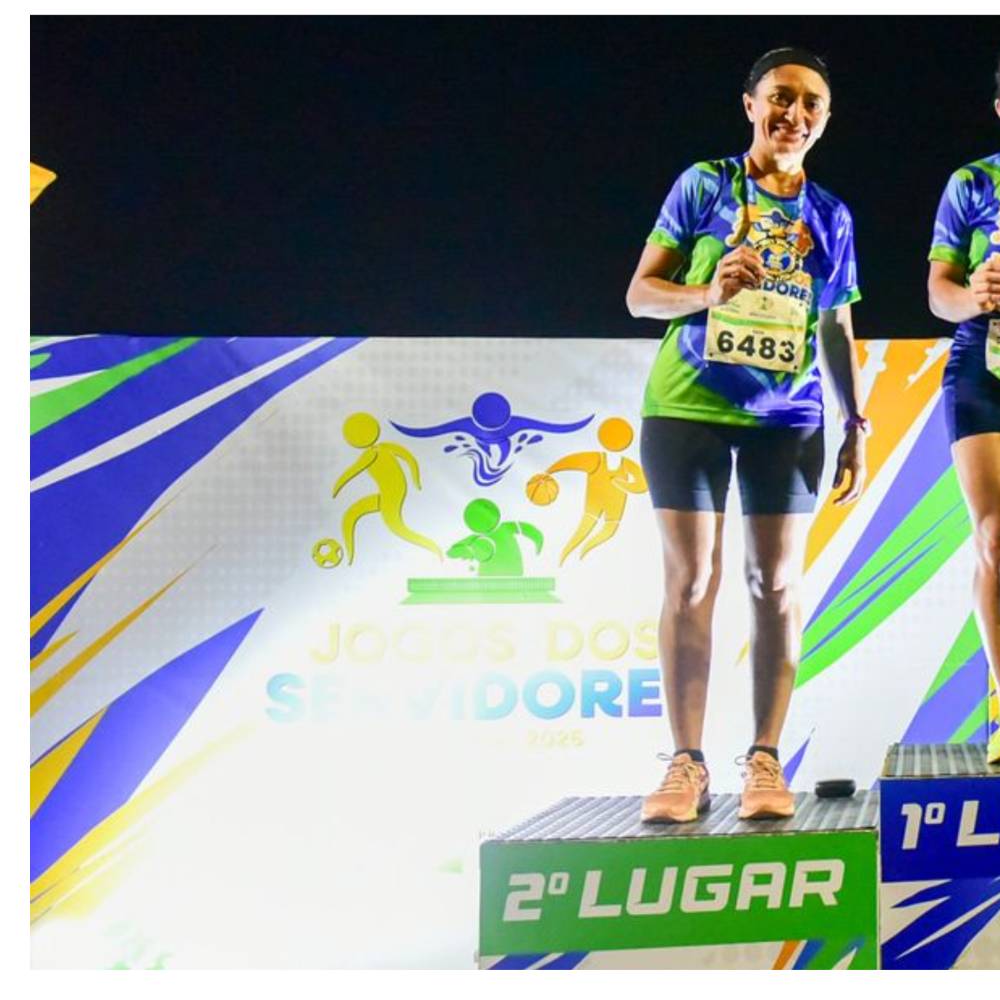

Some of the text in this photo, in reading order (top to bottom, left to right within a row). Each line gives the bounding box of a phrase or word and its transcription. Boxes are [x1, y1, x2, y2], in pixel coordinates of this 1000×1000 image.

[717, 330, 795, 363] 6483
[901, 802, 945, 850] 1º
[503, 859, 845, 921] 2º LUGAR
